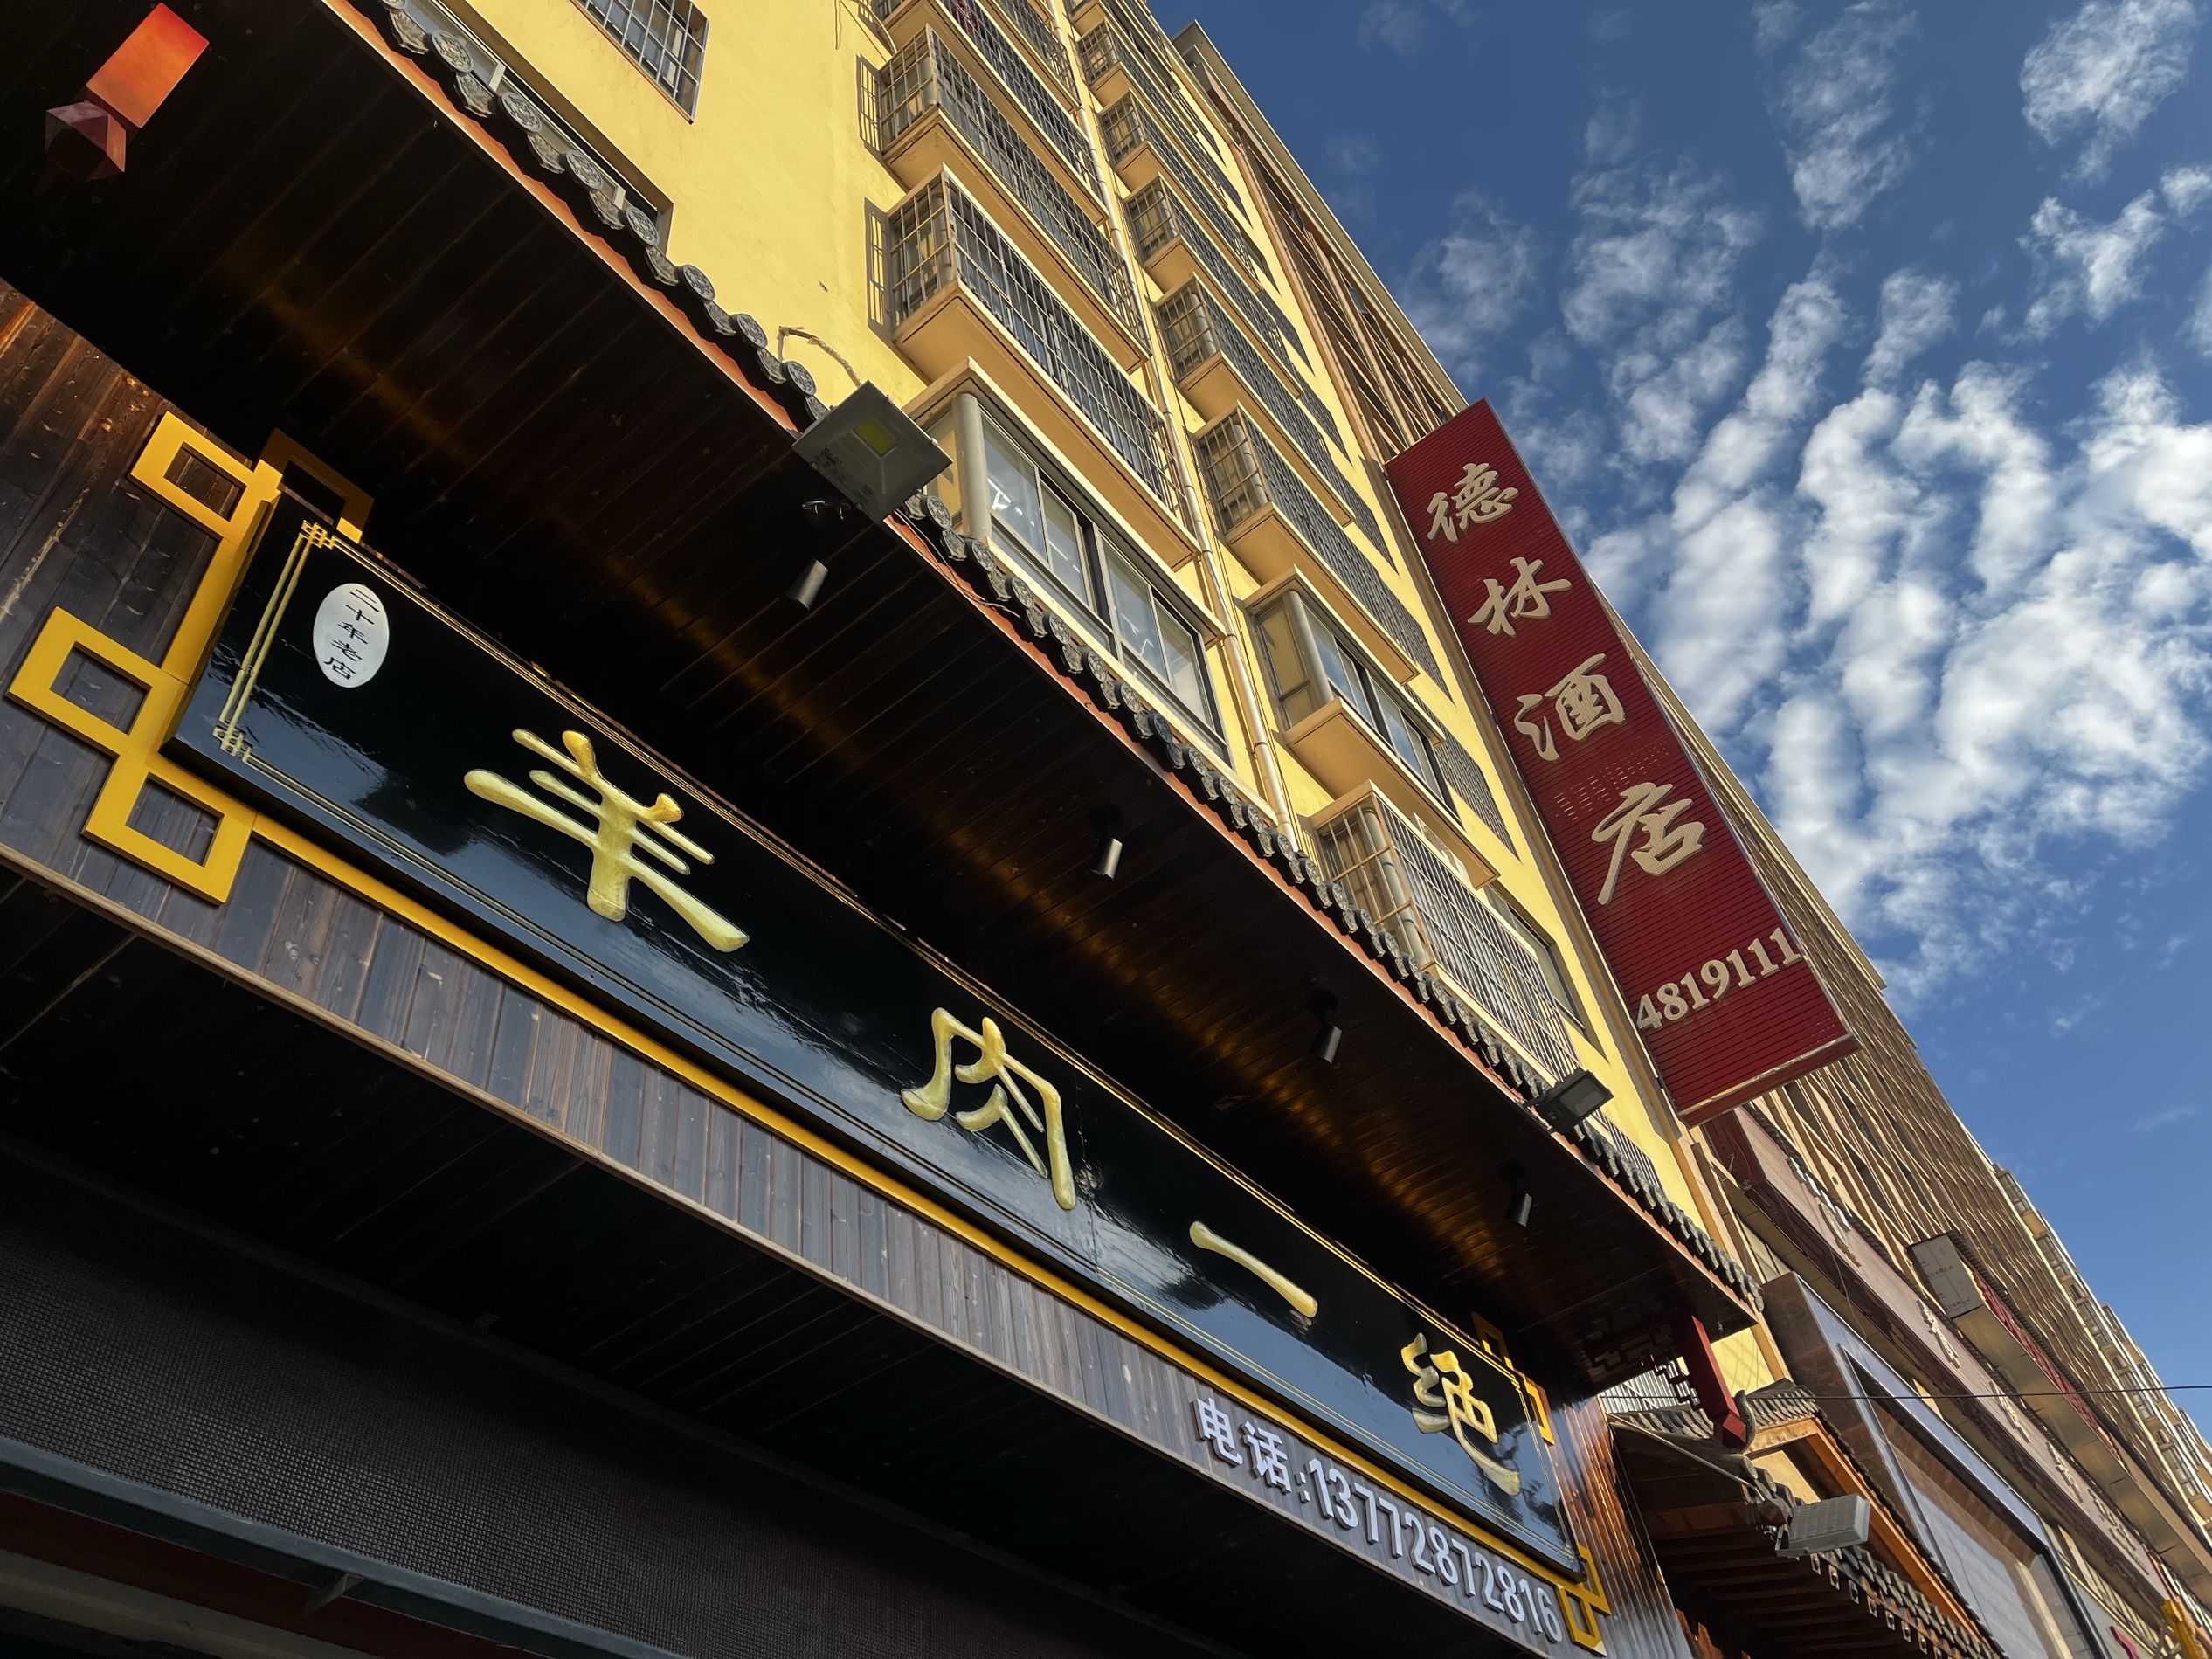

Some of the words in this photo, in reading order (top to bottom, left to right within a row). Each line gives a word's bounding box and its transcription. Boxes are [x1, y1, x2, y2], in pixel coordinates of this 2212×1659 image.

[323, 589, 380, 680] 二十年老店
[1427, 462, 1707, 906] 德林酒店
[463, 729, 1522, 1495] 羊肉一绝
[1636, 927, 1802, 1030] 4819111
